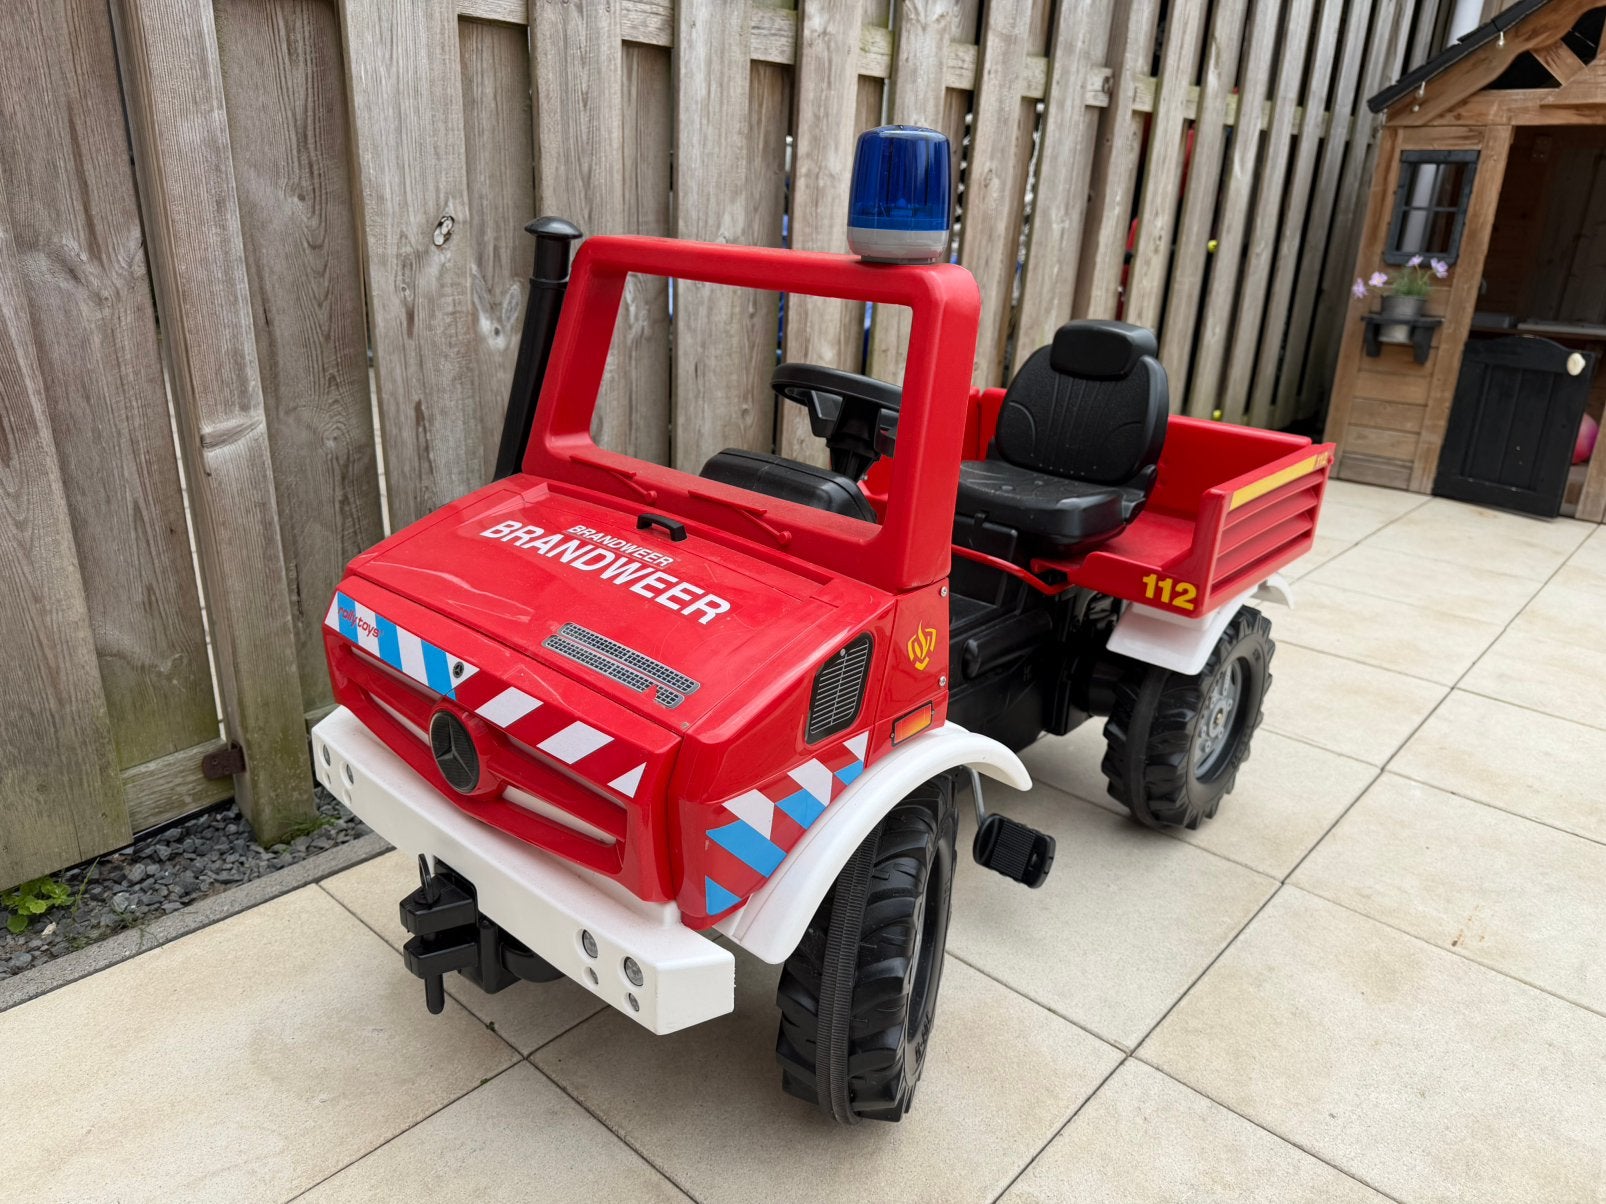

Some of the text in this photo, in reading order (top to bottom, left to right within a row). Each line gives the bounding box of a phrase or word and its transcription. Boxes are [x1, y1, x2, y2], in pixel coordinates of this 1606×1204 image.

[568, 525, 674, 567] BRANDWEER
[479, 520, 731, 625] BRANDWEER
[1143, 573, 1197, 611] 112
